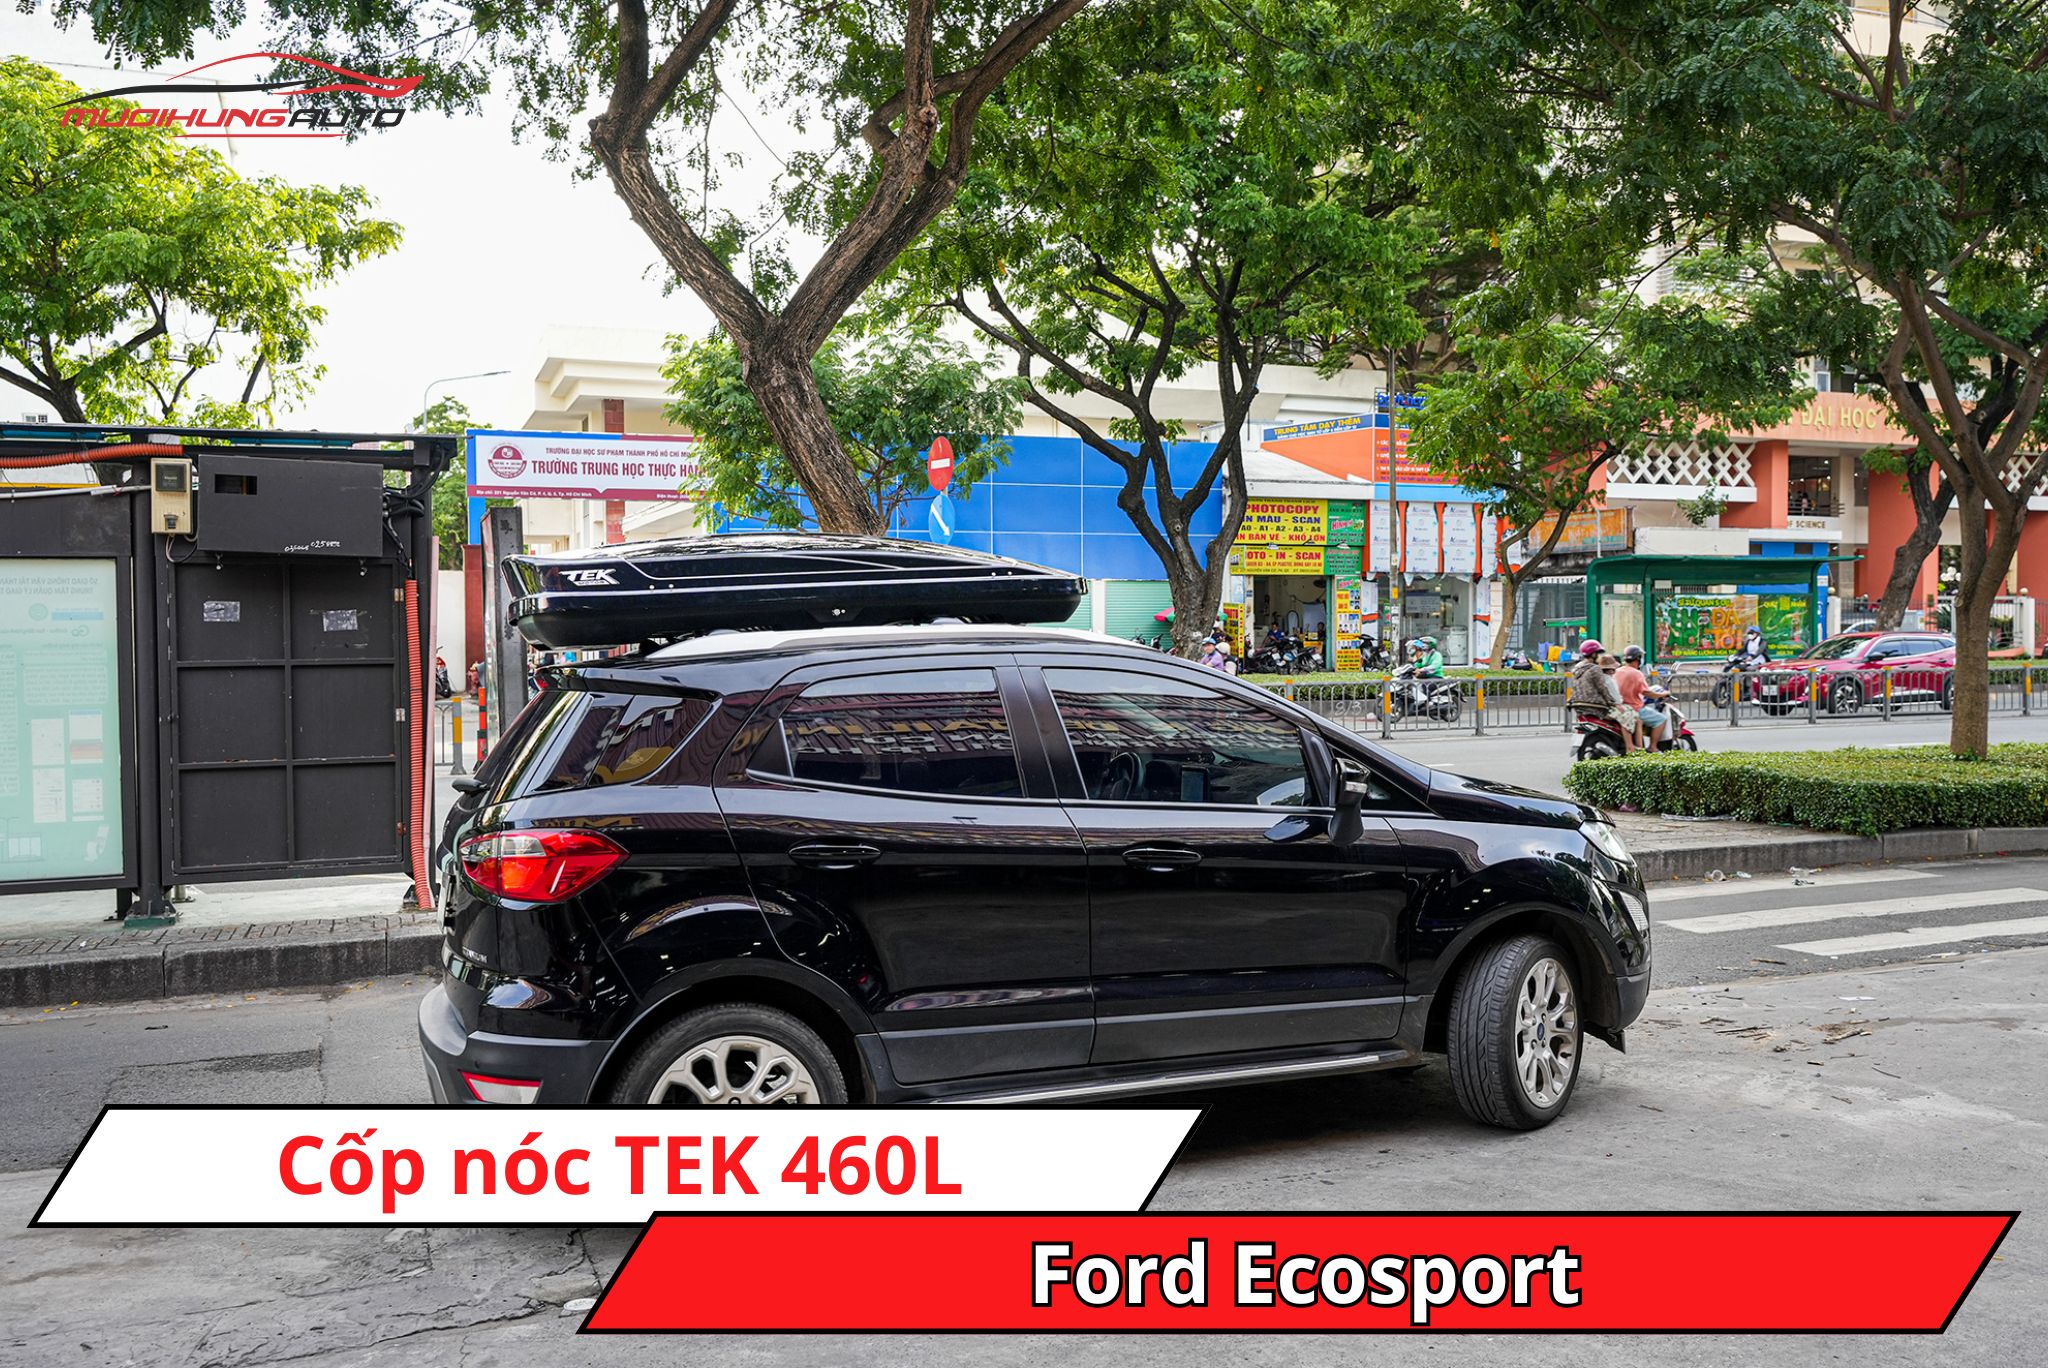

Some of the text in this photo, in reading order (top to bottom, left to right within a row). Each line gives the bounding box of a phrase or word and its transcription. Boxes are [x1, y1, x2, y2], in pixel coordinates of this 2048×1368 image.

[1801, 406, 1832, 431] ĐẠI
[1841, 407, 1877, 433] HỌC
[1274, 426, 1298, 435] TRUNG
[545, 447, 570, 455] TRƯỜNG
[583, 448, 595, 456] HỌC
[606, 449, 624, 457] PHẠM
[532, 457, 577, 475] TRƯỜNG
[581, 462, 618, 476] TRUNG
[622, 462, 645, 479] HỌC
[648, 463, 676, 480] THỰC
[1246, 503, 1319, 514] PHOTOCOPY
[1292, 516, 1321, 524] SCAN
[1795, 520, 1826, 529] SCIENCE
[1275, 551, 1286, 560] IN
[1295, 552, 1321, 560] SCAN
[558, 568, 620, 585] TEK
